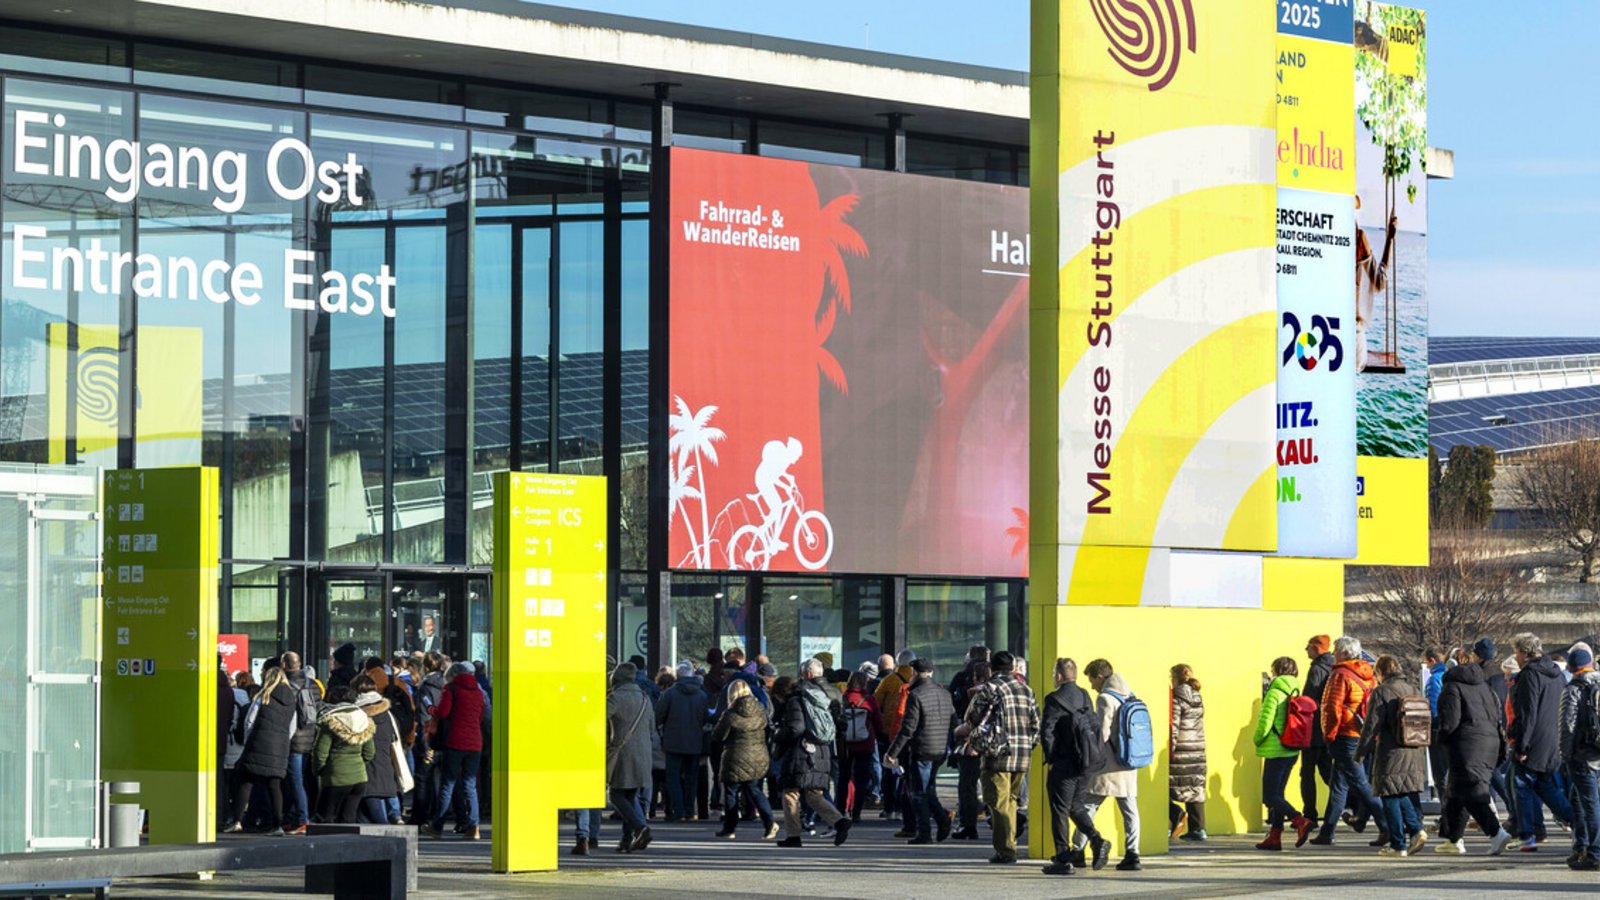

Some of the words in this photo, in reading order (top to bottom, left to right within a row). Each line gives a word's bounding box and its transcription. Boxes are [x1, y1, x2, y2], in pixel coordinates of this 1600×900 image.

[1281, 4, 1321, 29] 2025
[1389, 26, 1415, 46] ADAC
[1277, 51, 1306, 68] AND
[13, 109, 247, 213] Eingang
[266, 137, 363, 206] Ost
[700, 200, 768, 226] Fahrrad-
[771, 209, 784, 228] &
[683, 220, 800, 251] WanderReisen
[1086, 129, 1121, 348] Stuttgart
[1296, 231, 1334, 245] CHEMNITZ
[1334, 235, 1350, 247] 2025
[1292, 245, 1323, 258] REGION.
[12, 224, 263, 306] Entrance
[284, 248, 396, 317] East
[1086, 366, 1112, 514] Messe
[558, 507, 582, 527] ICS
[1357, 505, 1373, 519] en
[546, 537, 552, 556] 1
